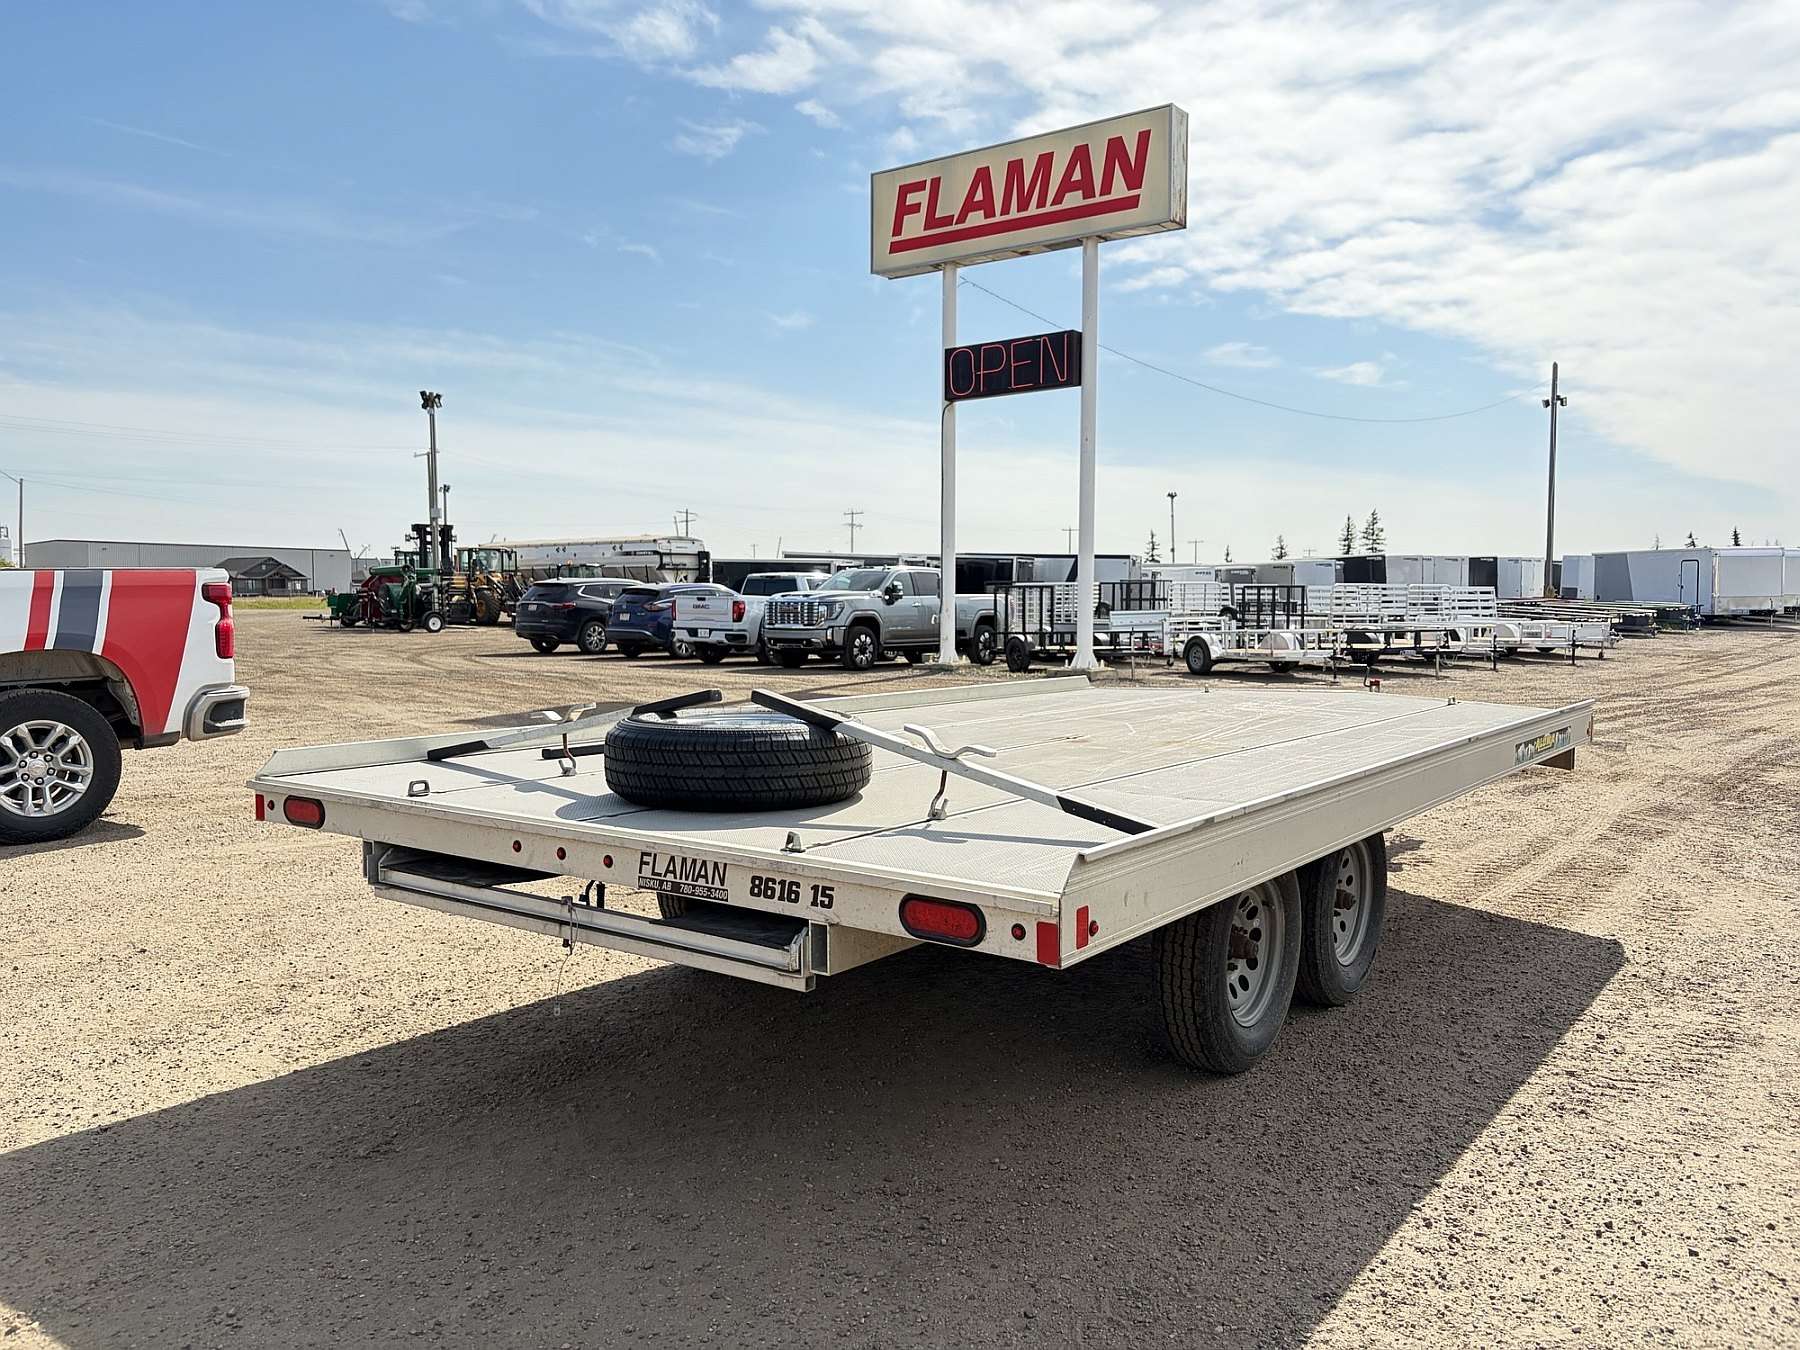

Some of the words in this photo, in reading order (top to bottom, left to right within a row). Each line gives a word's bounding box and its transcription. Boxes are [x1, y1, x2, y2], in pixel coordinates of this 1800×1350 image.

[892, 129, 1152, 237] FLAMAN
[949, 333, 1068, 396] OPEN
[638, 852, 728, 886] FLAMAN
[639, 876, 661, 890] NISKU,
[661, 880, 672, 891] AB
[679, 883, 728, 900] 780-955-3400
[749, 875, 801, 904] 8616
[810, 883, 835, 909] 15
